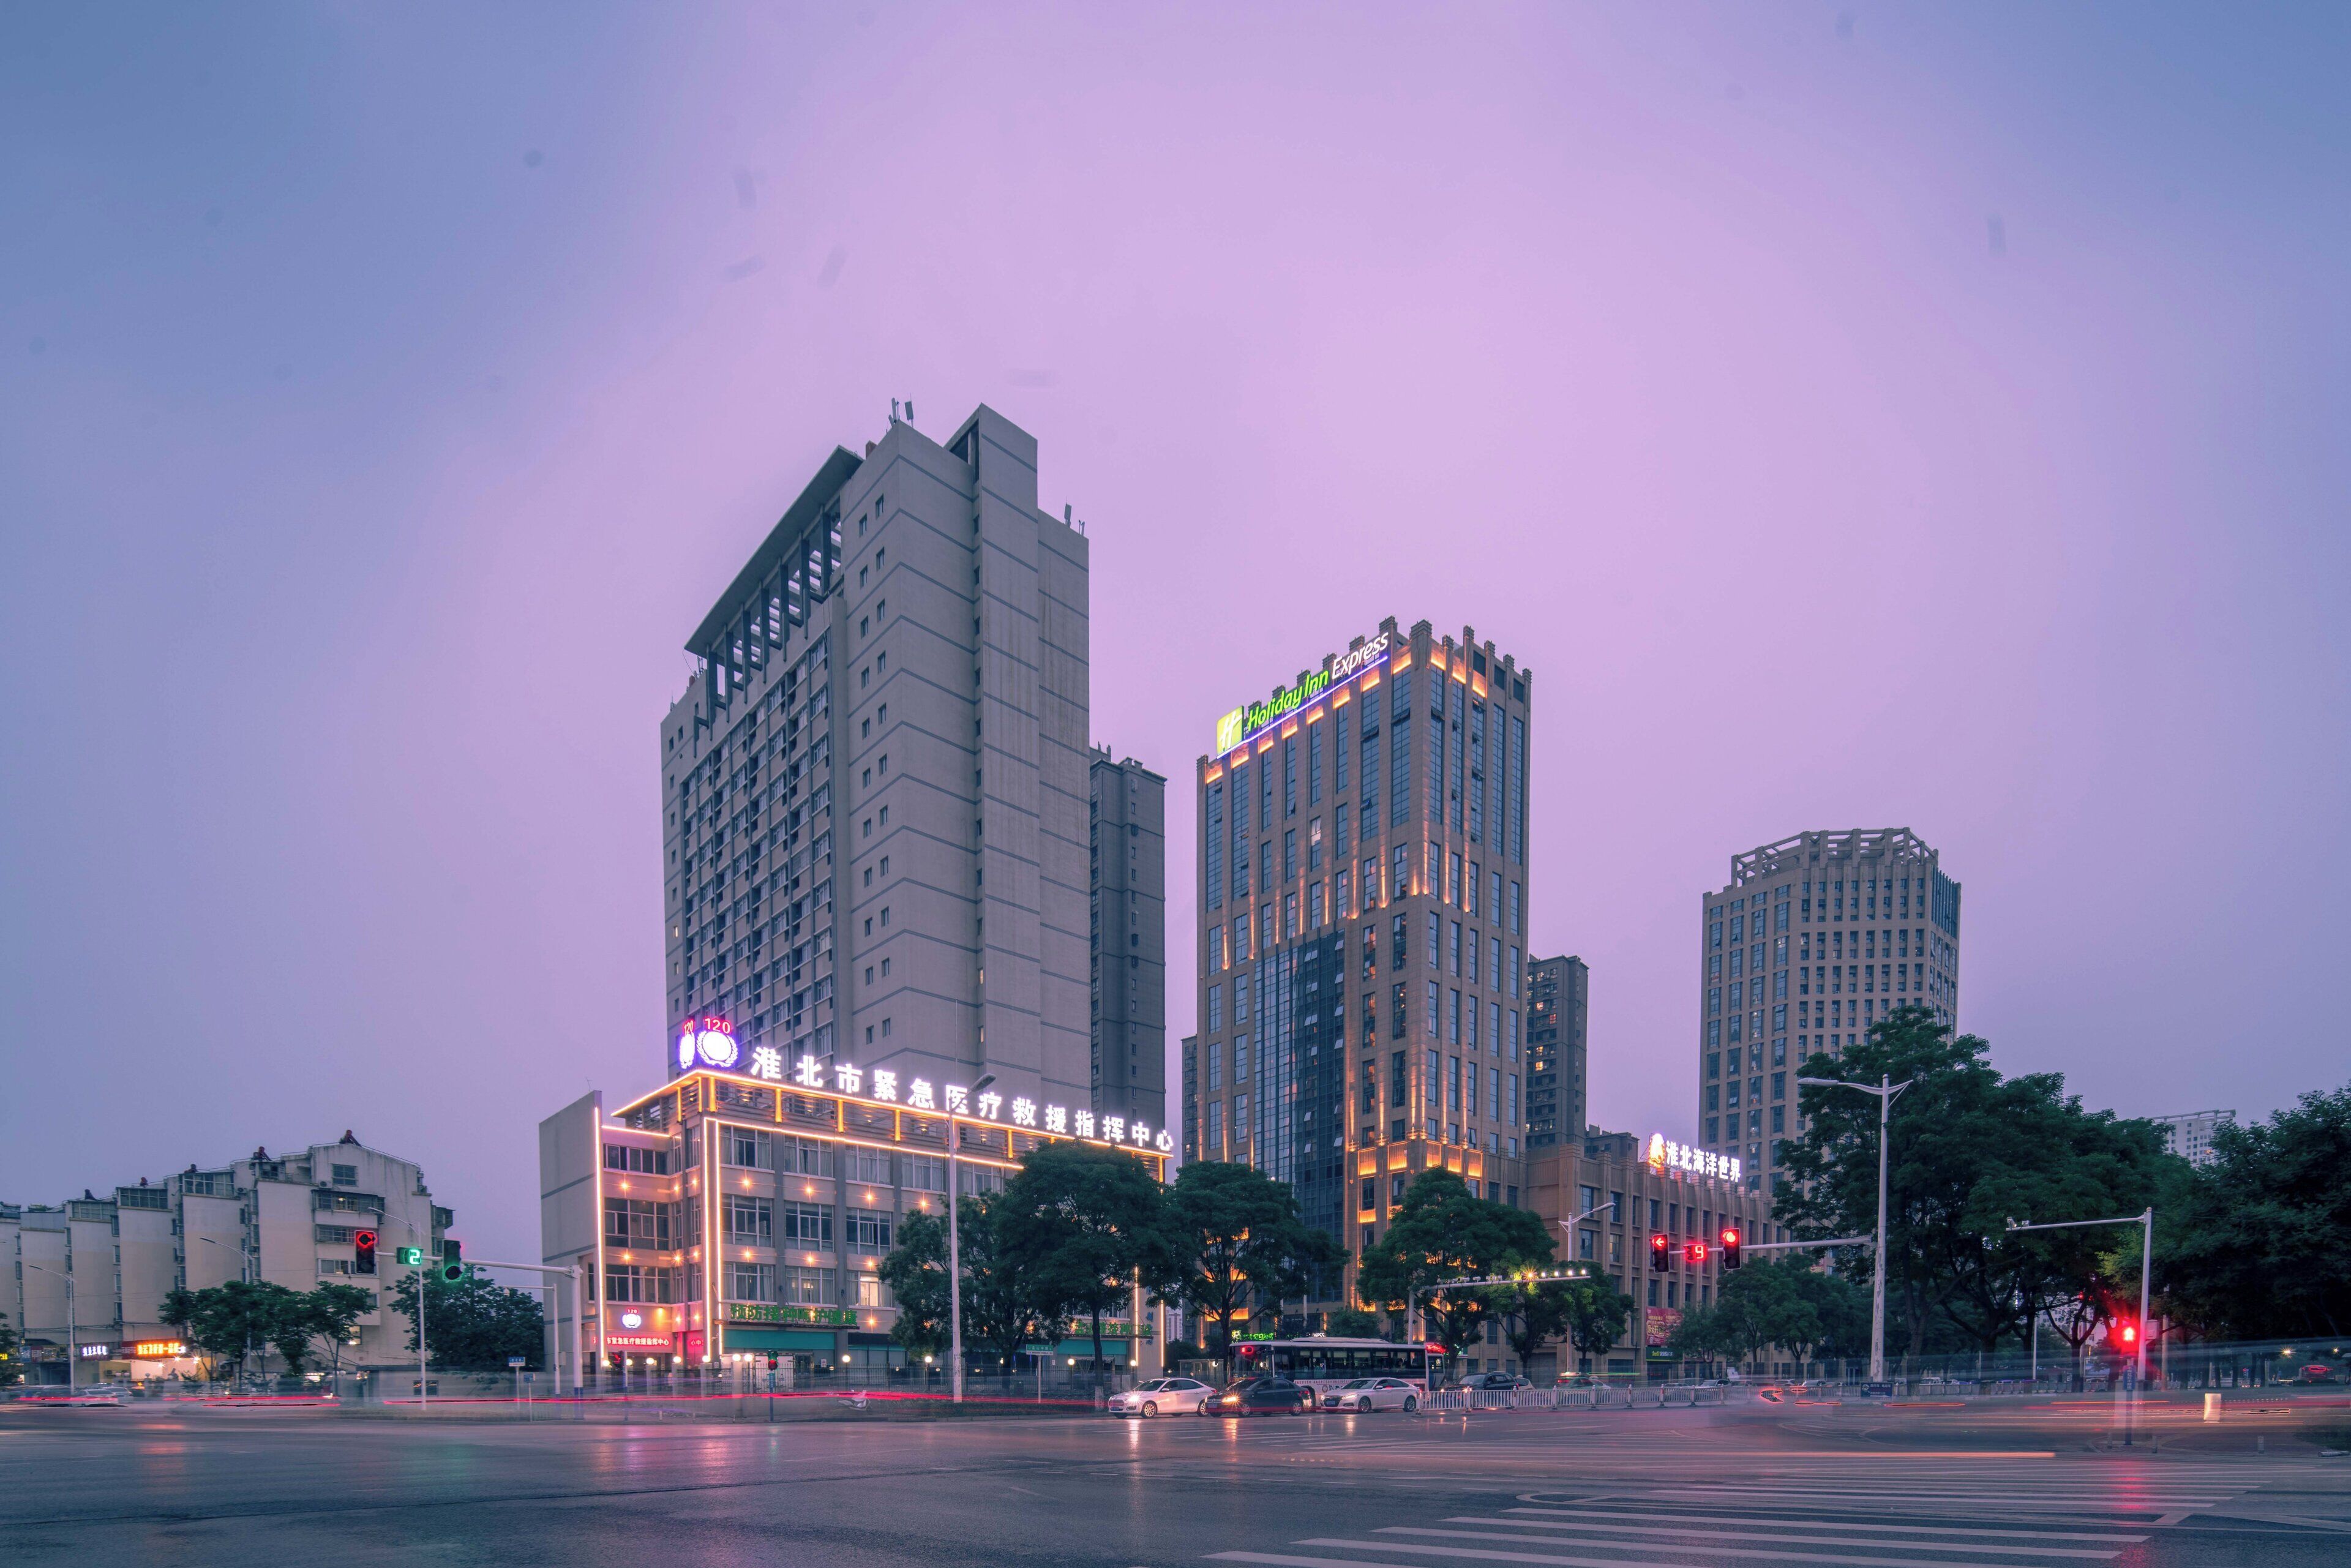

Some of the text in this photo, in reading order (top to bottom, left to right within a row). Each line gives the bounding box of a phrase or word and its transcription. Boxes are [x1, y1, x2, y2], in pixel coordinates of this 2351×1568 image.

[1247, 632, 1389, 732] Holiday Inn Express
[684, 1020, 694, 1035] 120
[705, 1018, 731, 1034] 120
[749, 1046, 1174, 1152] 淮北市紧急医疗救援指挥中心
[1666, 1140, 1741, 1182] 淮北海洋世界
[410, 1249, 421, 1264] 2
[1695, 1245, 1704, 1259] 9
[730, 1303, 857, 1326] 预防接种呵护健康
[593, 1337, 669, 1346] 市紧急医疗救援指挥中心
